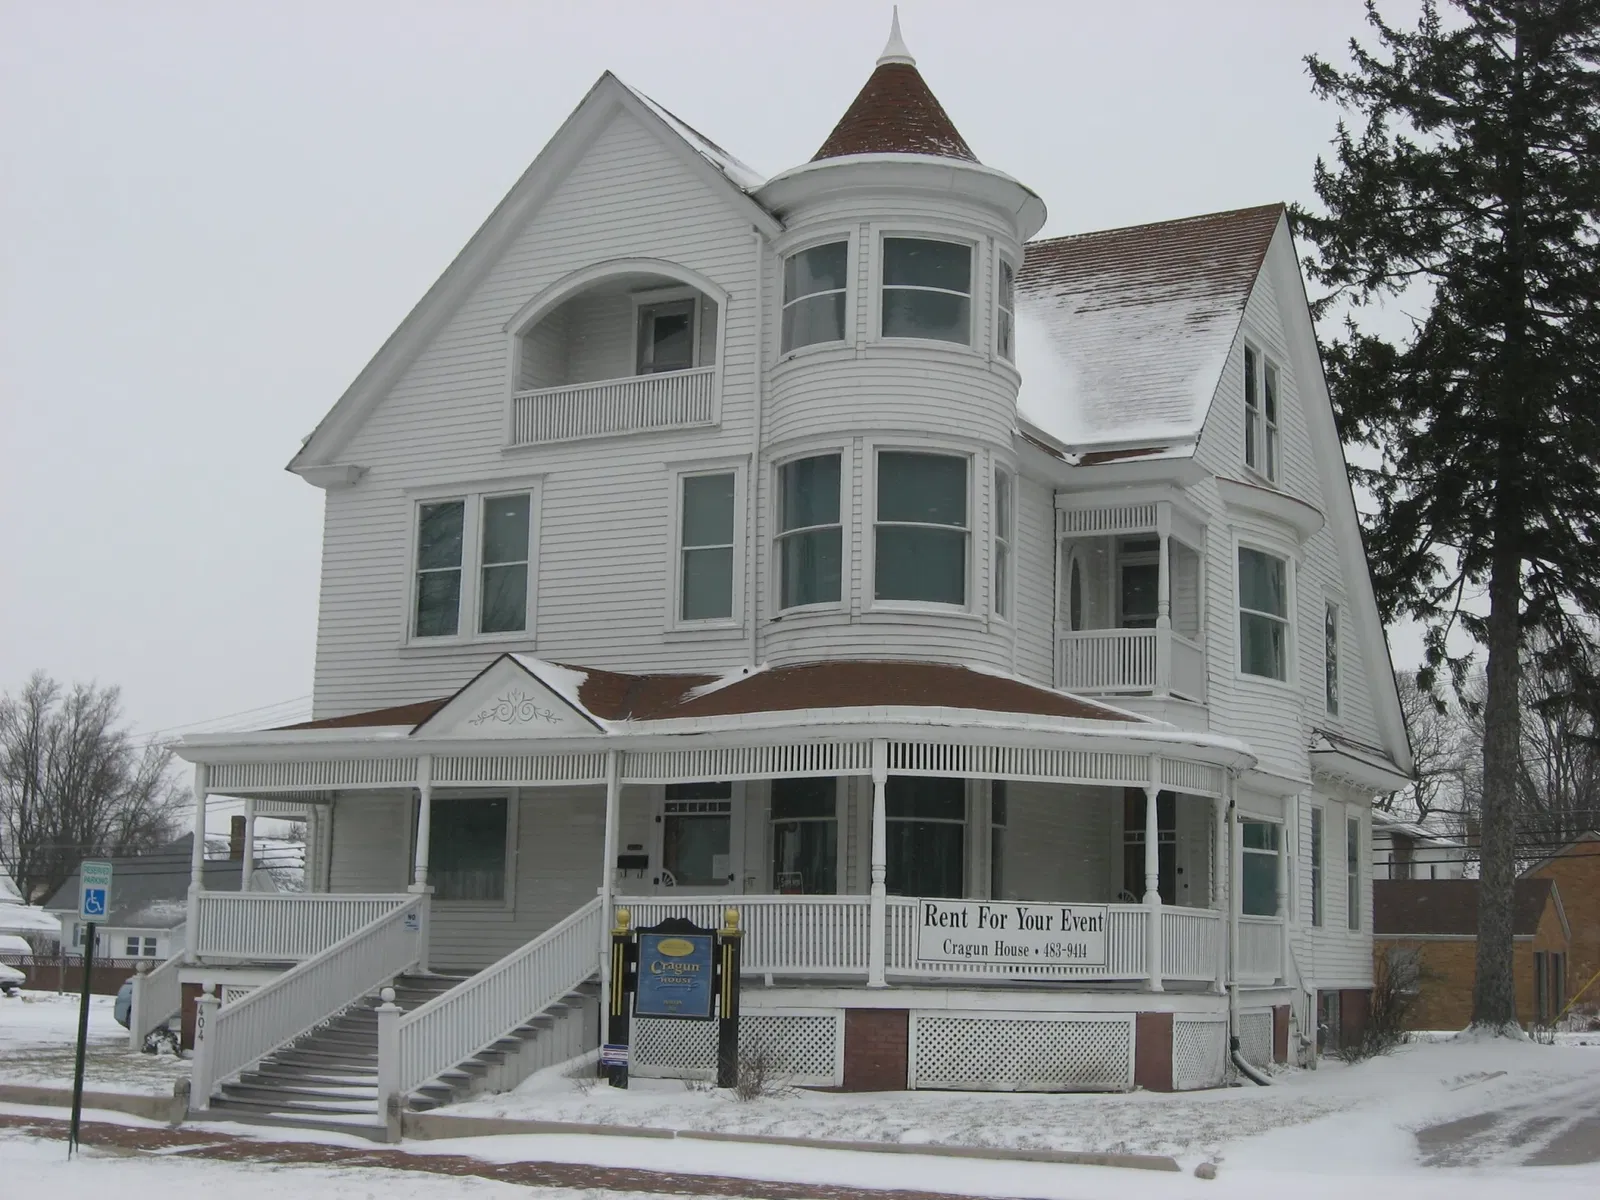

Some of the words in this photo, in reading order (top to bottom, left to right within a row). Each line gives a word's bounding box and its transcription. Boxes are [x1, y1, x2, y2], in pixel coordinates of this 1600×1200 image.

[83, 865, 109, 875] RESERVED
[83, 875, 109, 885] PARKING
[924, 903, 968, 928] Rent
[977, 905, 1008, 930] For
[1016, 907, 1053, 931] Your
[1060, 908, 1104, 932] Event
[943, 938, 989, 958] Cragun
[994, 940, 1029, 957] House
[1043, 942, 1087, 958] 483-9414
[650, 960, 700, 975] Cragun
